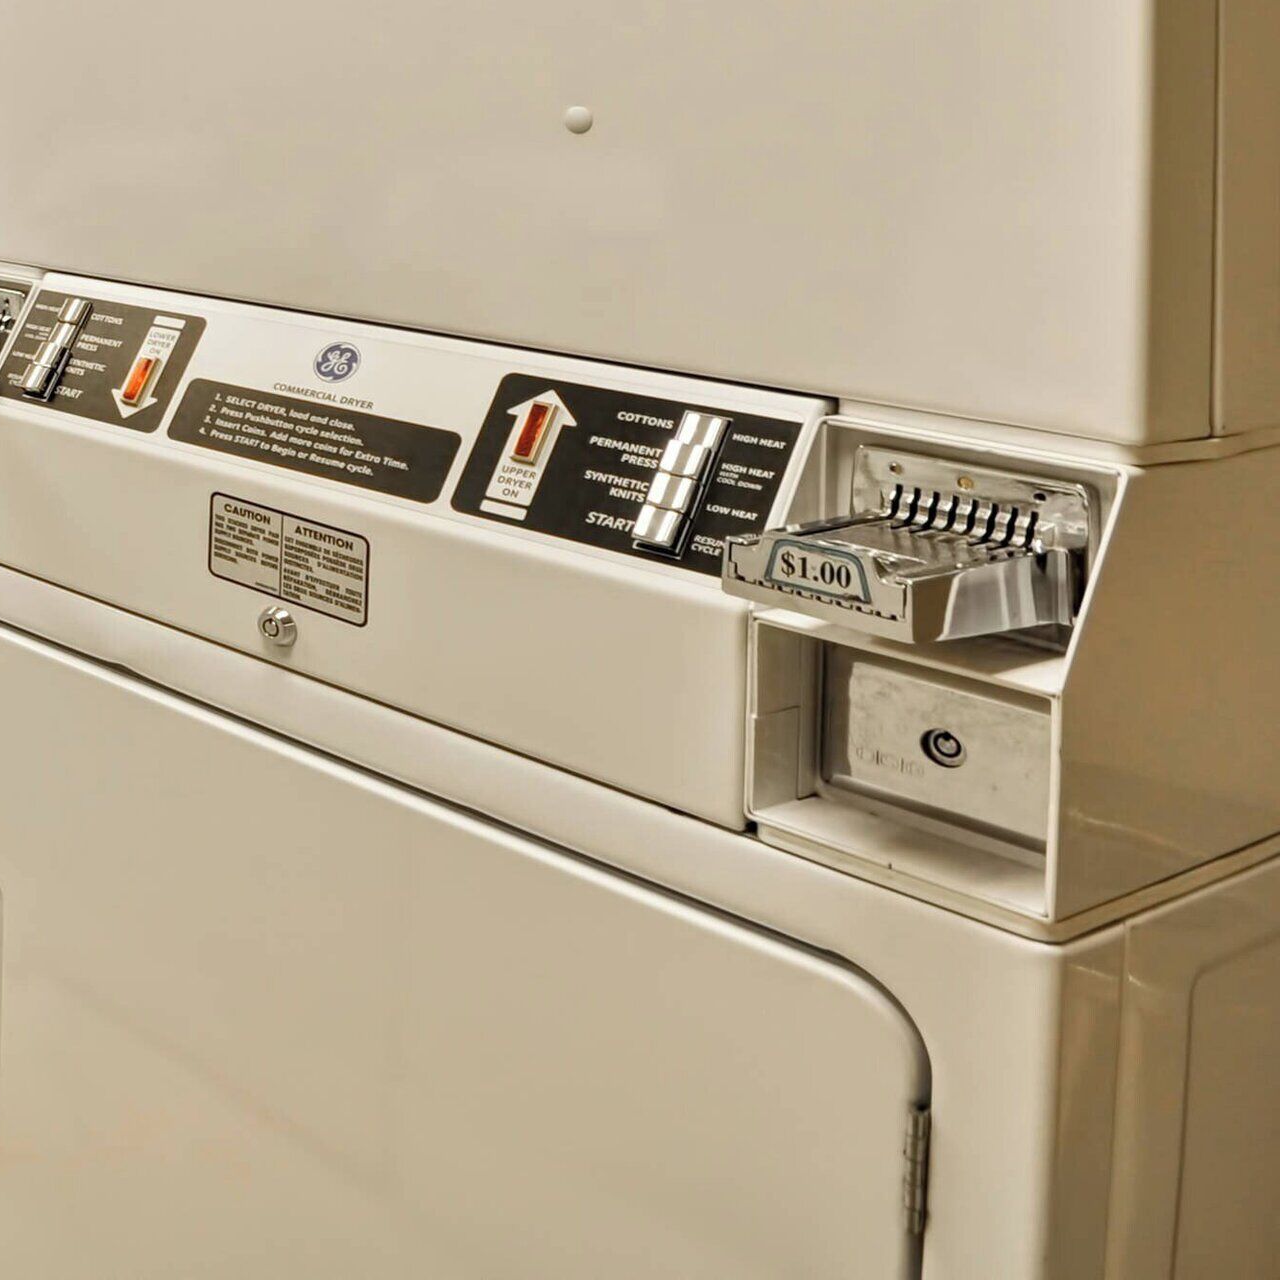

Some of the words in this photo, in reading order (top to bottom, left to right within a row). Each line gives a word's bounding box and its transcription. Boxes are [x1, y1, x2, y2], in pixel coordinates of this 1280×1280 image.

[55, 385, 84, 399] START
[273, 382, 338, 402] COMMERCIAL
[339, 396, 375, 410] DRYER
[214, 393, 222, 402] 1.
[225, 395, 257, 408] SELECT
[256, 402, 288, 417] DRYER,
[288, 409, 311, 420] load
[309, 415, 329, 425] and
[329, 418, 356, 431] close.
[616, 411, 675, 430] COTTONS
[208, 404, 217, 413] 2.
[219, 406, 243, 419] Press
[244, 412, 295, 430] Pushbutton
[295, 424, 319, 435] cycle
[319, 430, 364, 447] selection.
[214, 418, 241, 431] Insert
[241, 423, 268, 437] Coins.
[268, 431, 289, 442] Add
[288, 436, 313, 447] more
[313, 441, 339, 454] coins
[338, 446, 355, 457] for
[354, 450, 381, 464] Extra
[382, 456, 410, 471] Time.
[589, 435, 663, 458] PERMANENT
[732, 433, 759, 445] HIGH
[759, 437, 787, 450] HEAT
[209, 429, 234, 441] Press
[233, 435, 261, 448] START
[260, 441, 271, 451] to
[270, 444, 297, 458] Begin
[297, 451, 309, 460] or
[308, 453, 346, 469] Resume
[346, 463, 374, 476] cycle.
[620, 453, 659, 469] PRESS
[501, 465, 537, 480] UPPER
[583, 469, 650, 492] SYNTHETIC
[721, 462, 748, 474] HIGH
[748, 467, 775, 480] HEAT
[497, 476, 533, 491] DRYER
[716, 476, 737, 487] COOL
[502, 488, 519, 499] ON
[608, 487, 647, 503] KNITS
[223, 503, 271, 525] CAUTION
[706, 503, 731, 516] LOW
[731, 508, 758, 521] HEAT
[585, 511, 636, 533] START
[294, 524, 354, 551] ATTENTION
[691, 543, 722, 557] CYCLE
[780, 550, 852, 589] $1.00
